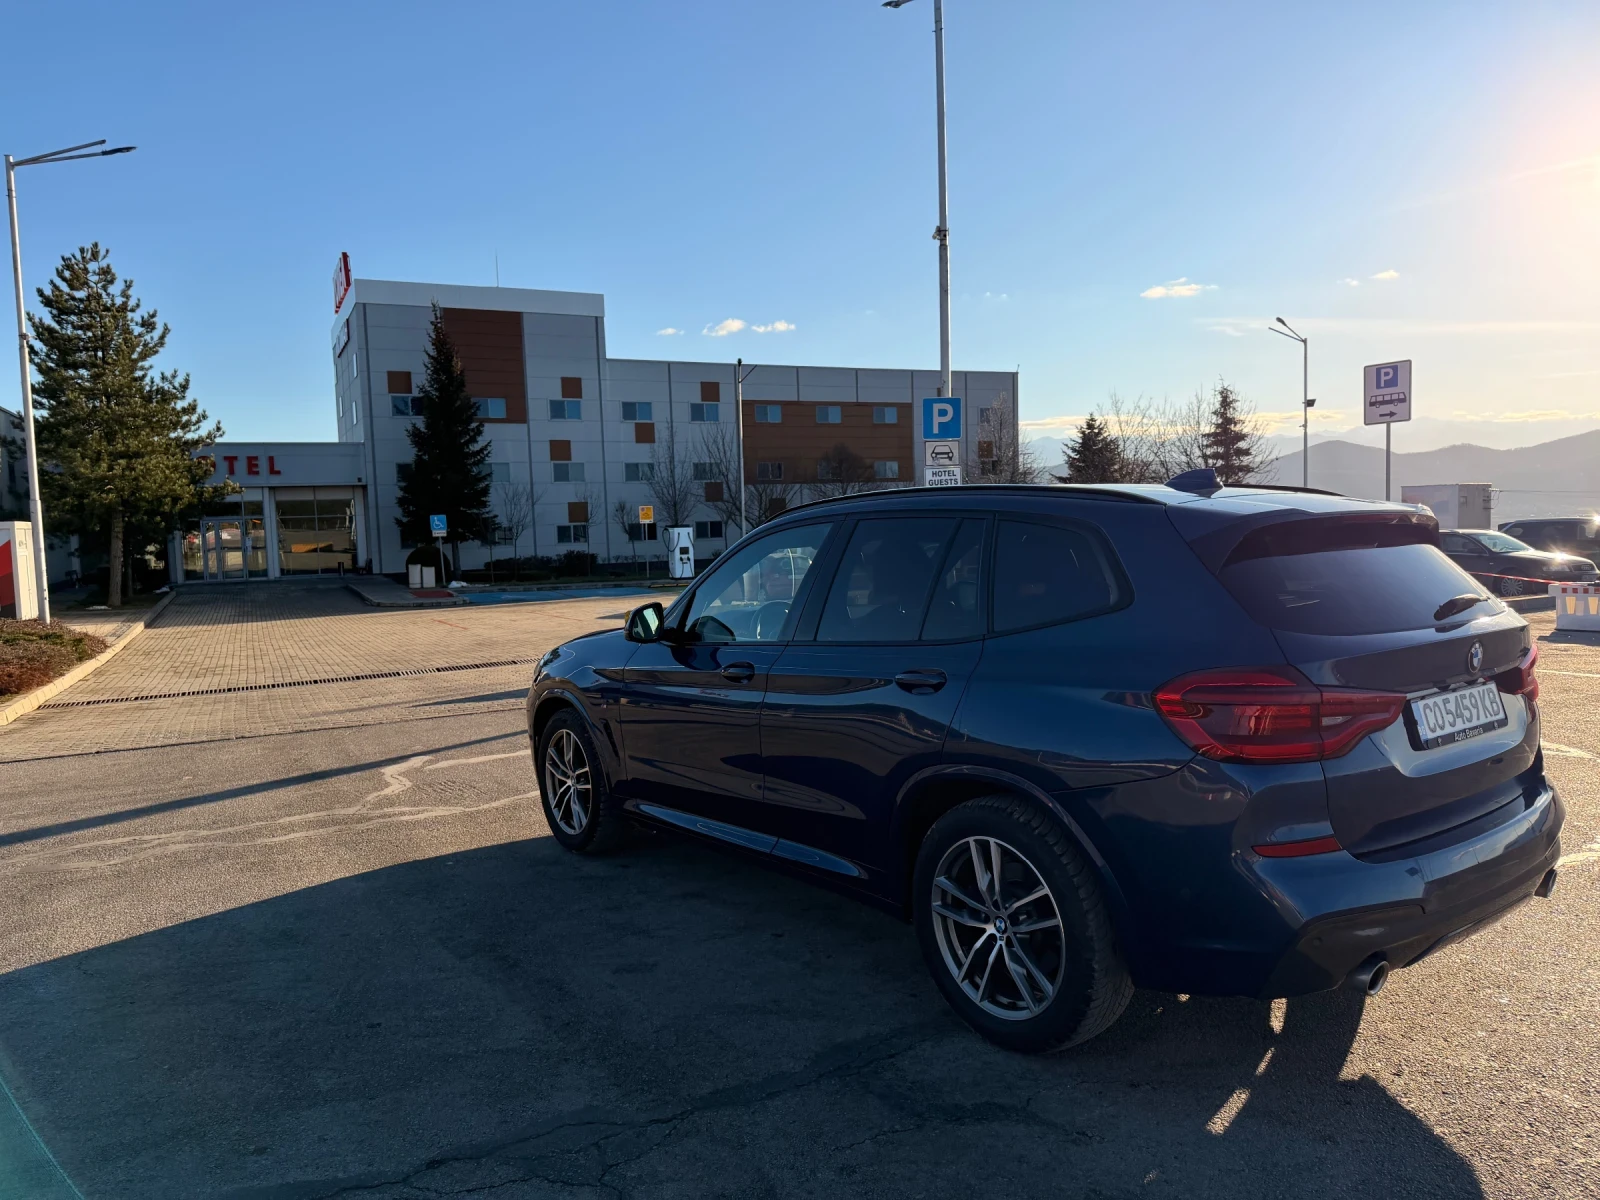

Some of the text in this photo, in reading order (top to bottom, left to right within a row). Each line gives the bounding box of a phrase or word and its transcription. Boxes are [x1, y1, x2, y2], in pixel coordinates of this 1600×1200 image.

[1380, 368, 1394, 387] P
[932, 403, 954, 434] P
[928, 478, 959, 486] GUESTS
[1454, 732, 1466, 741] Auto
